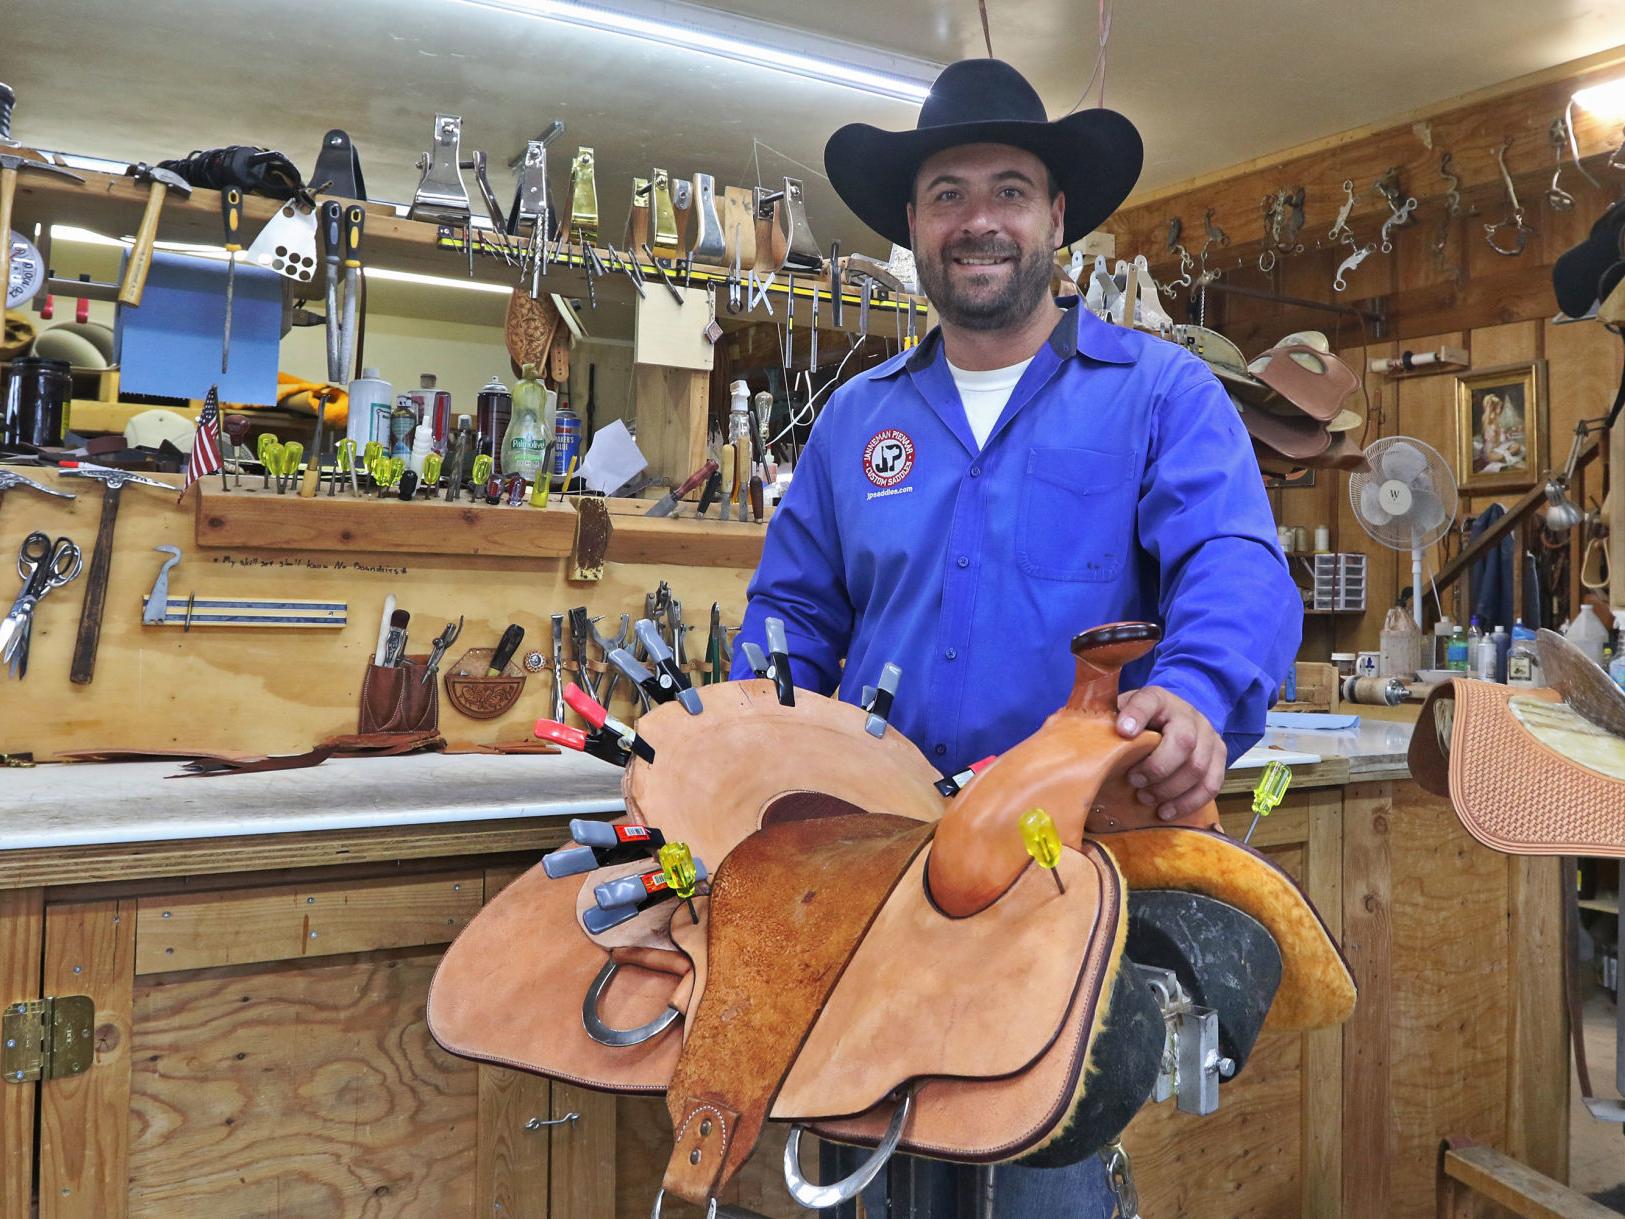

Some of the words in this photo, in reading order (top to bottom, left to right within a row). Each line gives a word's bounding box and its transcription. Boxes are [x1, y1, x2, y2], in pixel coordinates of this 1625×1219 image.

[512, 439, 545, 449] Palmolive
[892, 430, 914, 455] PIENAAR
[865, 466, 888, 487] CUSTOM
[887, 461, 913, 487] SADDLES
[866, 486, 913, 501] jpsaddles.com
